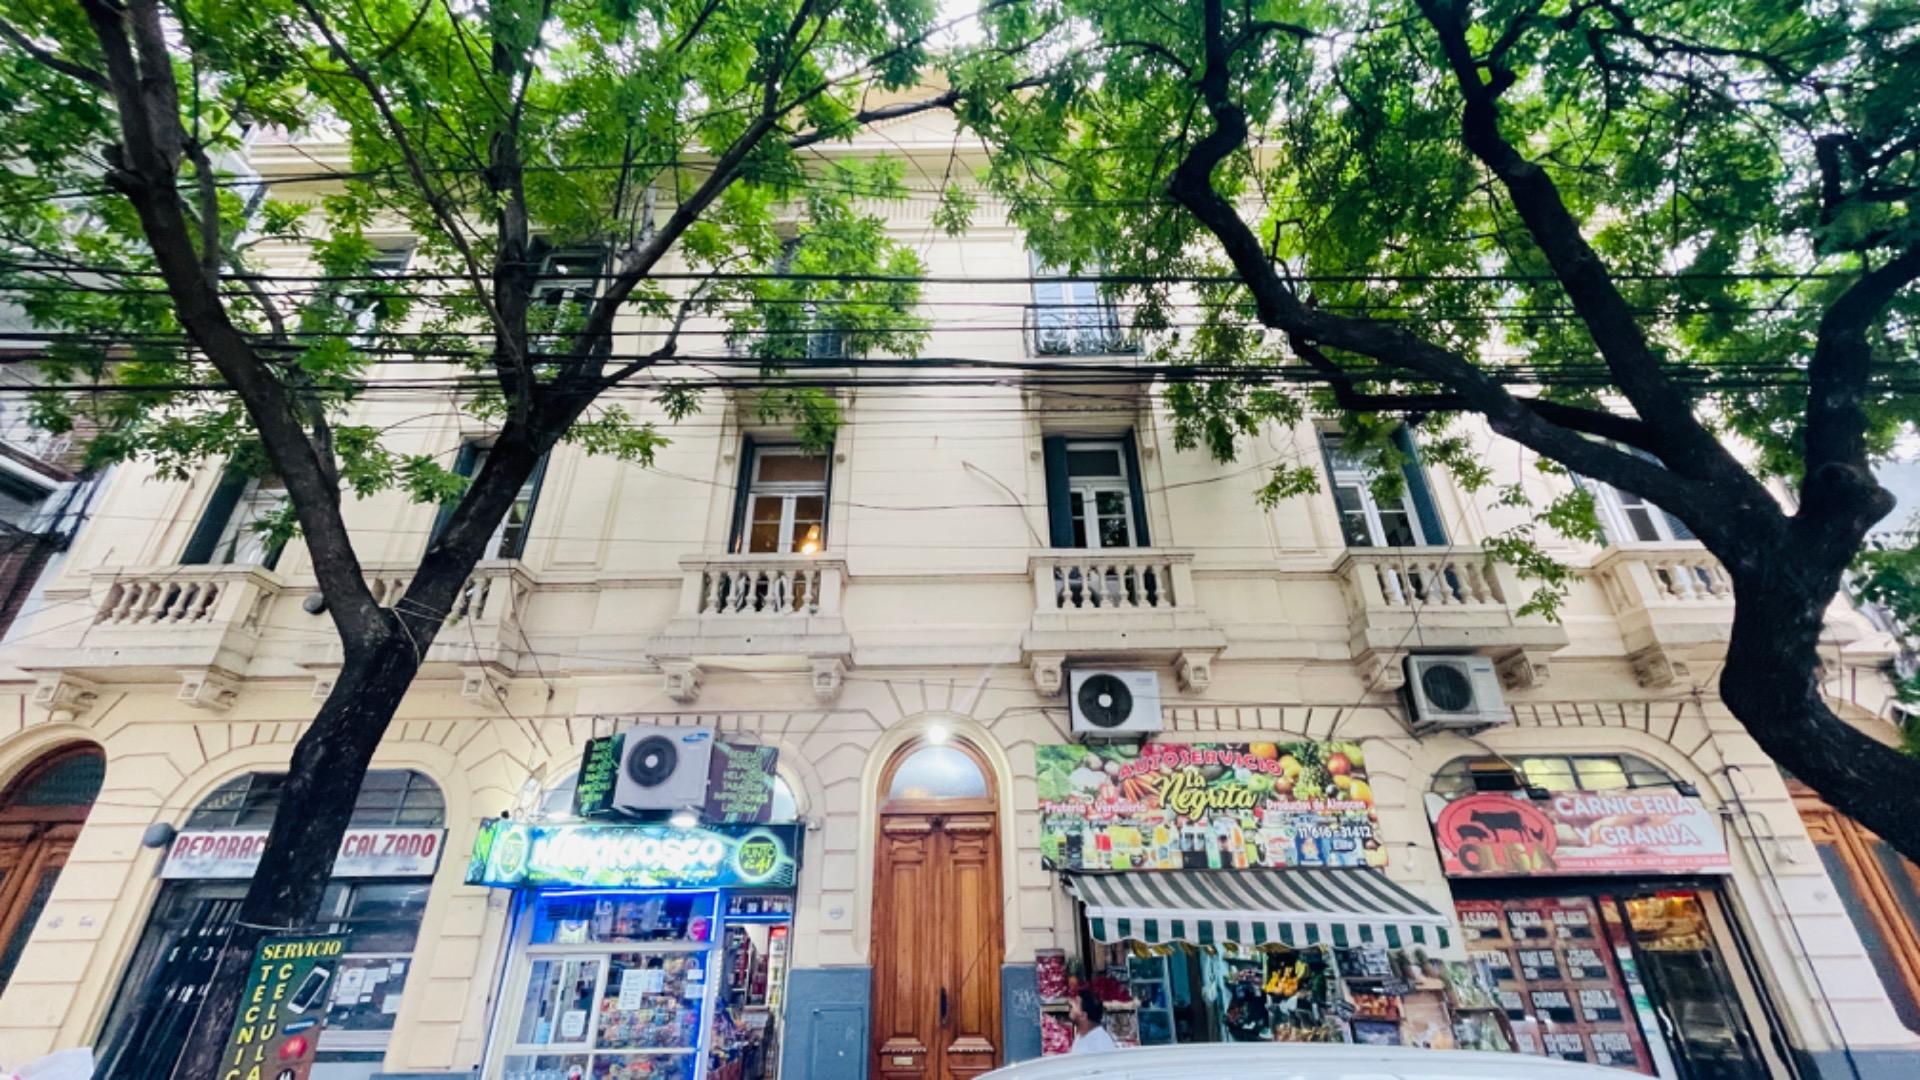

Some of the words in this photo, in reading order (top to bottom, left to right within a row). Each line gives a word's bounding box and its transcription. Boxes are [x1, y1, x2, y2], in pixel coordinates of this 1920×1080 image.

[1119, 749, 1283, 778] AUTOSERVICIO
[1184, 765, 1207, 788] La
[1153, 769, 1258, 821] Negrita
[1555, 795, 1697, 817] CARNICERIA
[172, 836, 268, 860] REPARAC
[342, 833, 438, 858] CALZADO
[1576, 828, 1593, 847] Y
[1600, 825, 1701, 847] GRANJA
[1457, 842, 1557, 872] OLGA
[261, 940, 342, 960] SERVICIO
